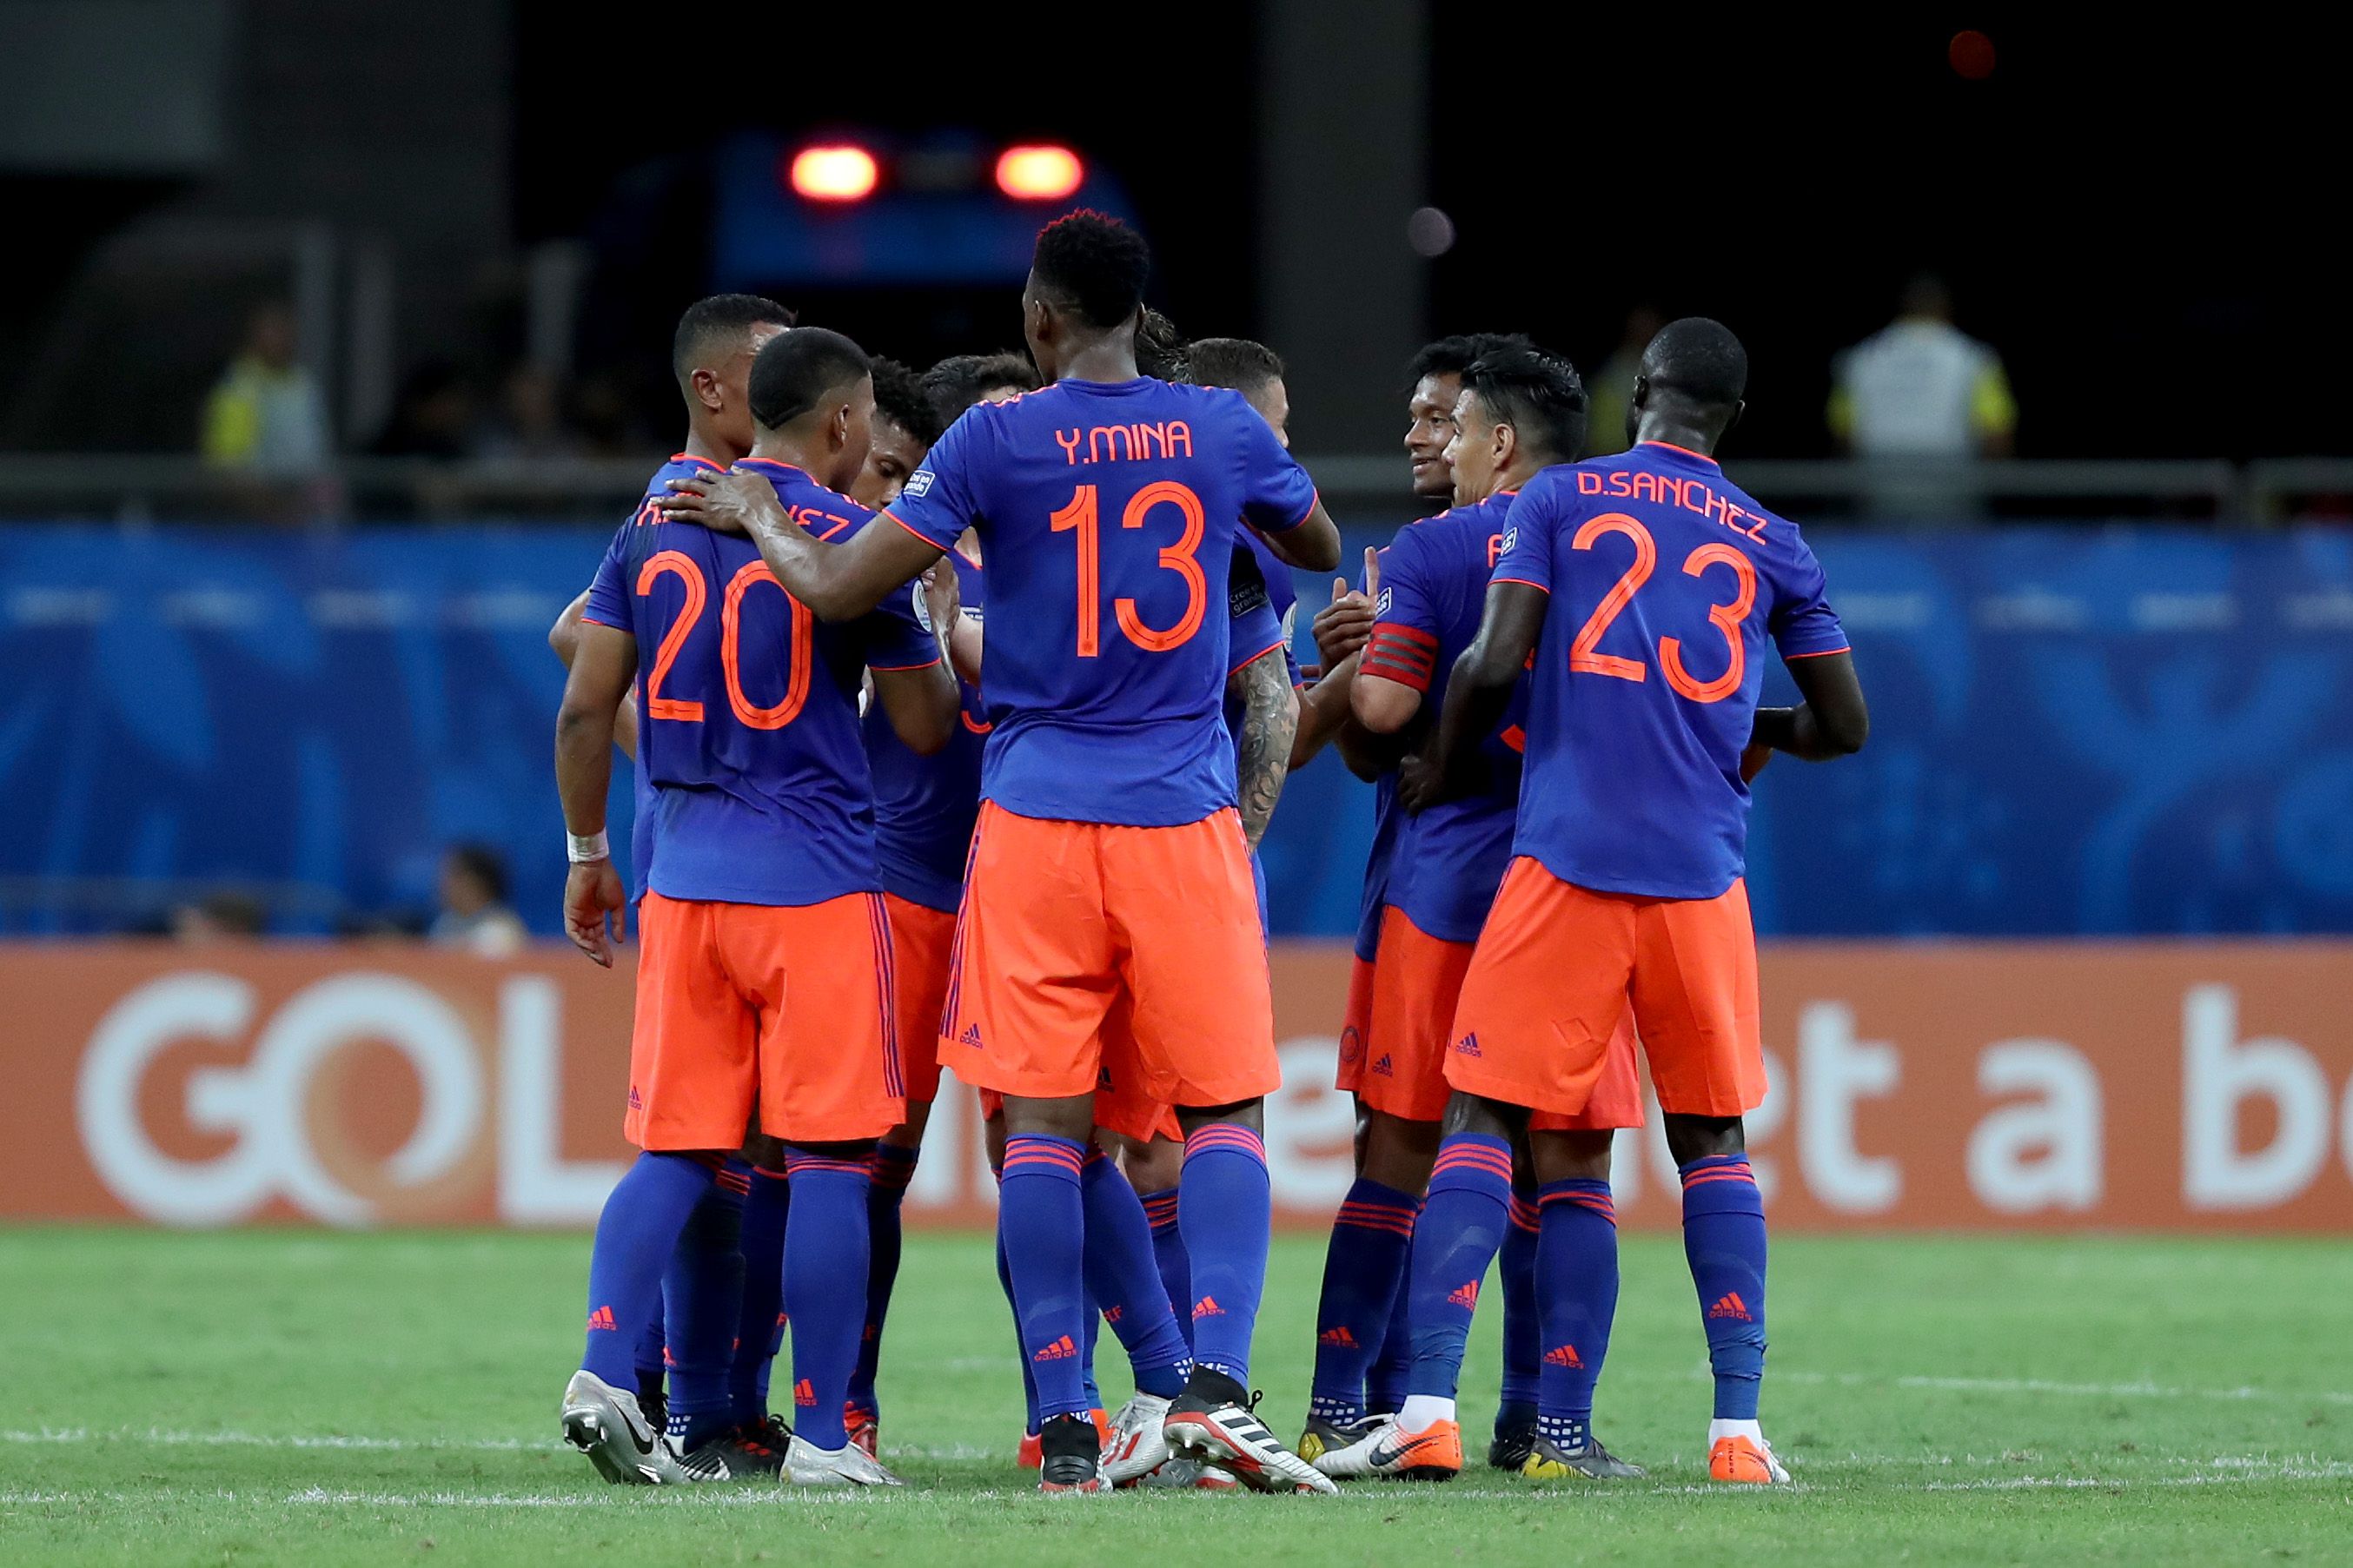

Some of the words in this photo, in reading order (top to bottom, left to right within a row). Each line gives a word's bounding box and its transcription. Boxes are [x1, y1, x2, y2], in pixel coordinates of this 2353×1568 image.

[1055, 420, 1192, 466] Y.MINA
[1050, 480, 1207, 658] 13
[1577, 471, 1767, 546] D.SANCHEZ
[636, 550, 813, 731] 20
[1569, 512, 1758, 704] 23
[76, 969, 639, 1227] GOL
[1964, 1038, 2104, 1213] a
[2179, 982, 2353, 1213] b
[1034, 1348, 1077, 1362] adidas
[1542, 1355, 1585, 1370] adidas
[1709, 1307, 1752, 1322] adidas
